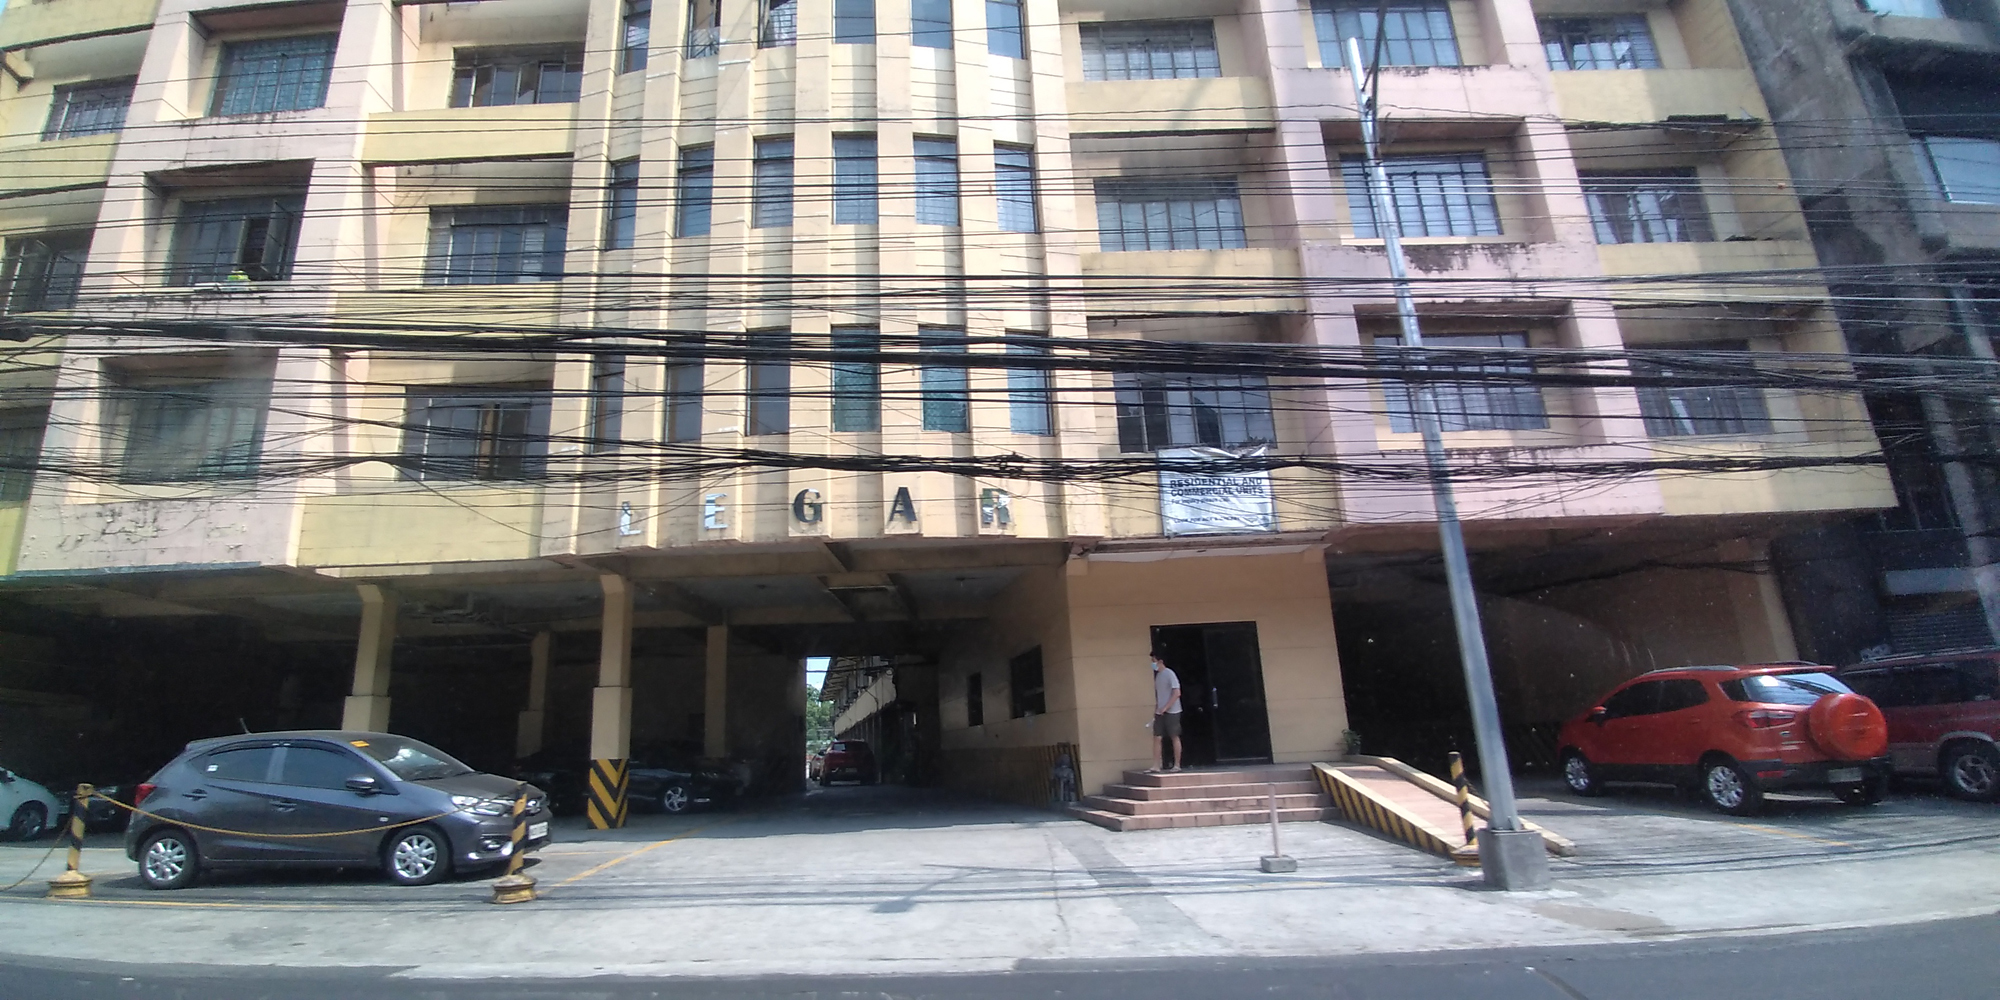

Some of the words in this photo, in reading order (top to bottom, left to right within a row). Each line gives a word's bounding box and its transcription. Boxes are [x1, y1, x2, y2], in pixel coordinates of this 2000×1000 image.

[1170, 478, 1238, 488] RESIDENTIAL
[1242, 477, 1262, 486] AND
[1170, 487, 1235, 497] COMMERCIAL
[1236, 486, 1263, 495] UNITS
